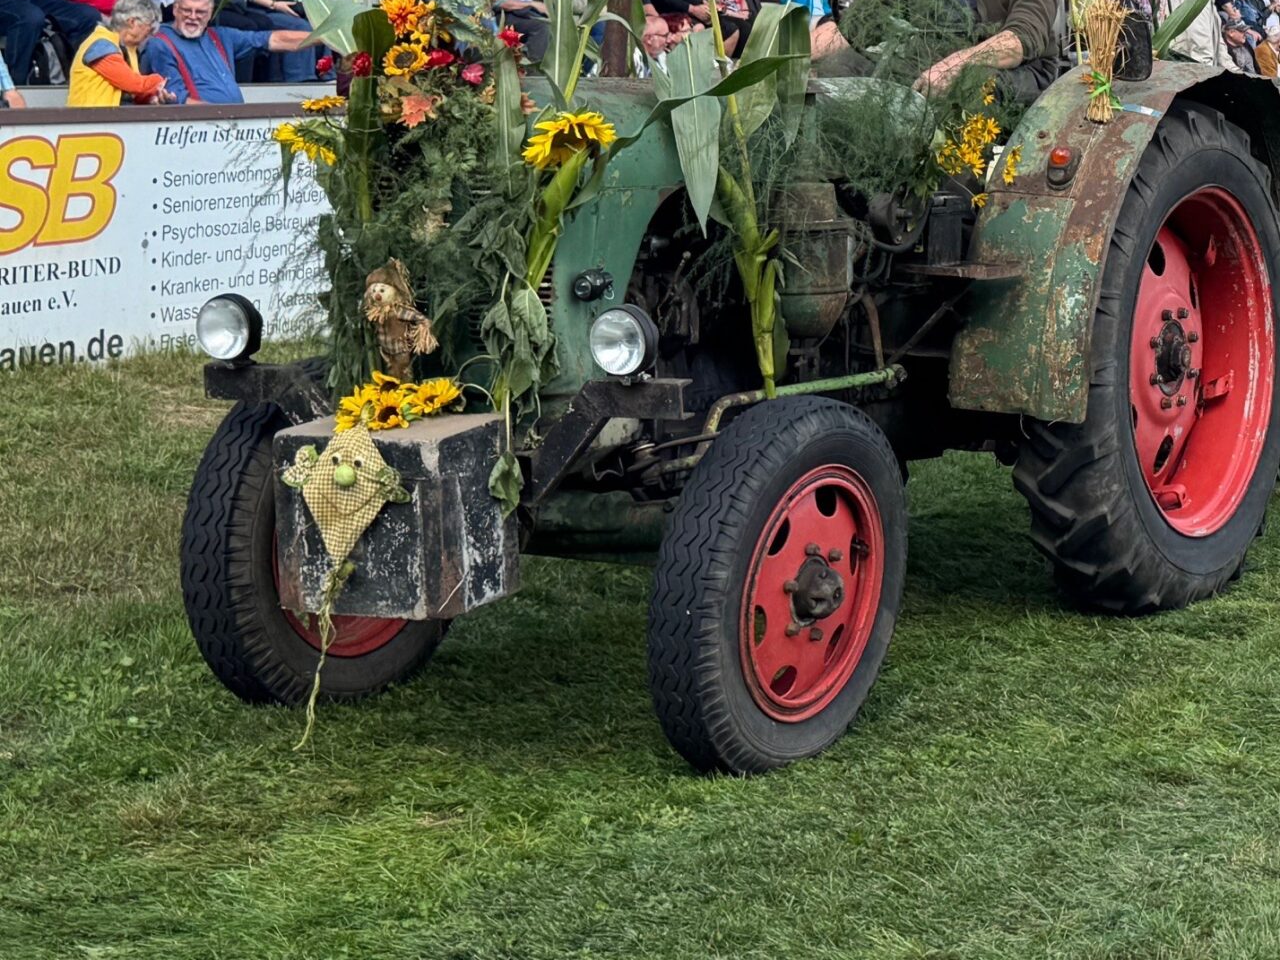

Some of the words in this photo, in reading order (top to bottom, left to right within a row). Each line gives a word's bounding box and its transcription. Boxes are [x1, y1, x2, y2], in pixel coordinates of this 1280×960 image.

[155, 127, 207, 149] Helfen
[213, 125, 231, 142] ist
[163, 166, 284, 188] Seniorenwohnpa
[162, 192, 280, 214] Seniorenzentrum
[162, 217, 261, 245] Psychosoziale
[162, 248, 211, 269] Kinder-
[216, 246, 242, 263] und
[161, 277, 225, 297] Kranken-
[228, 270, 255, 288] und
[48, 289, 77, 310] e.V.
